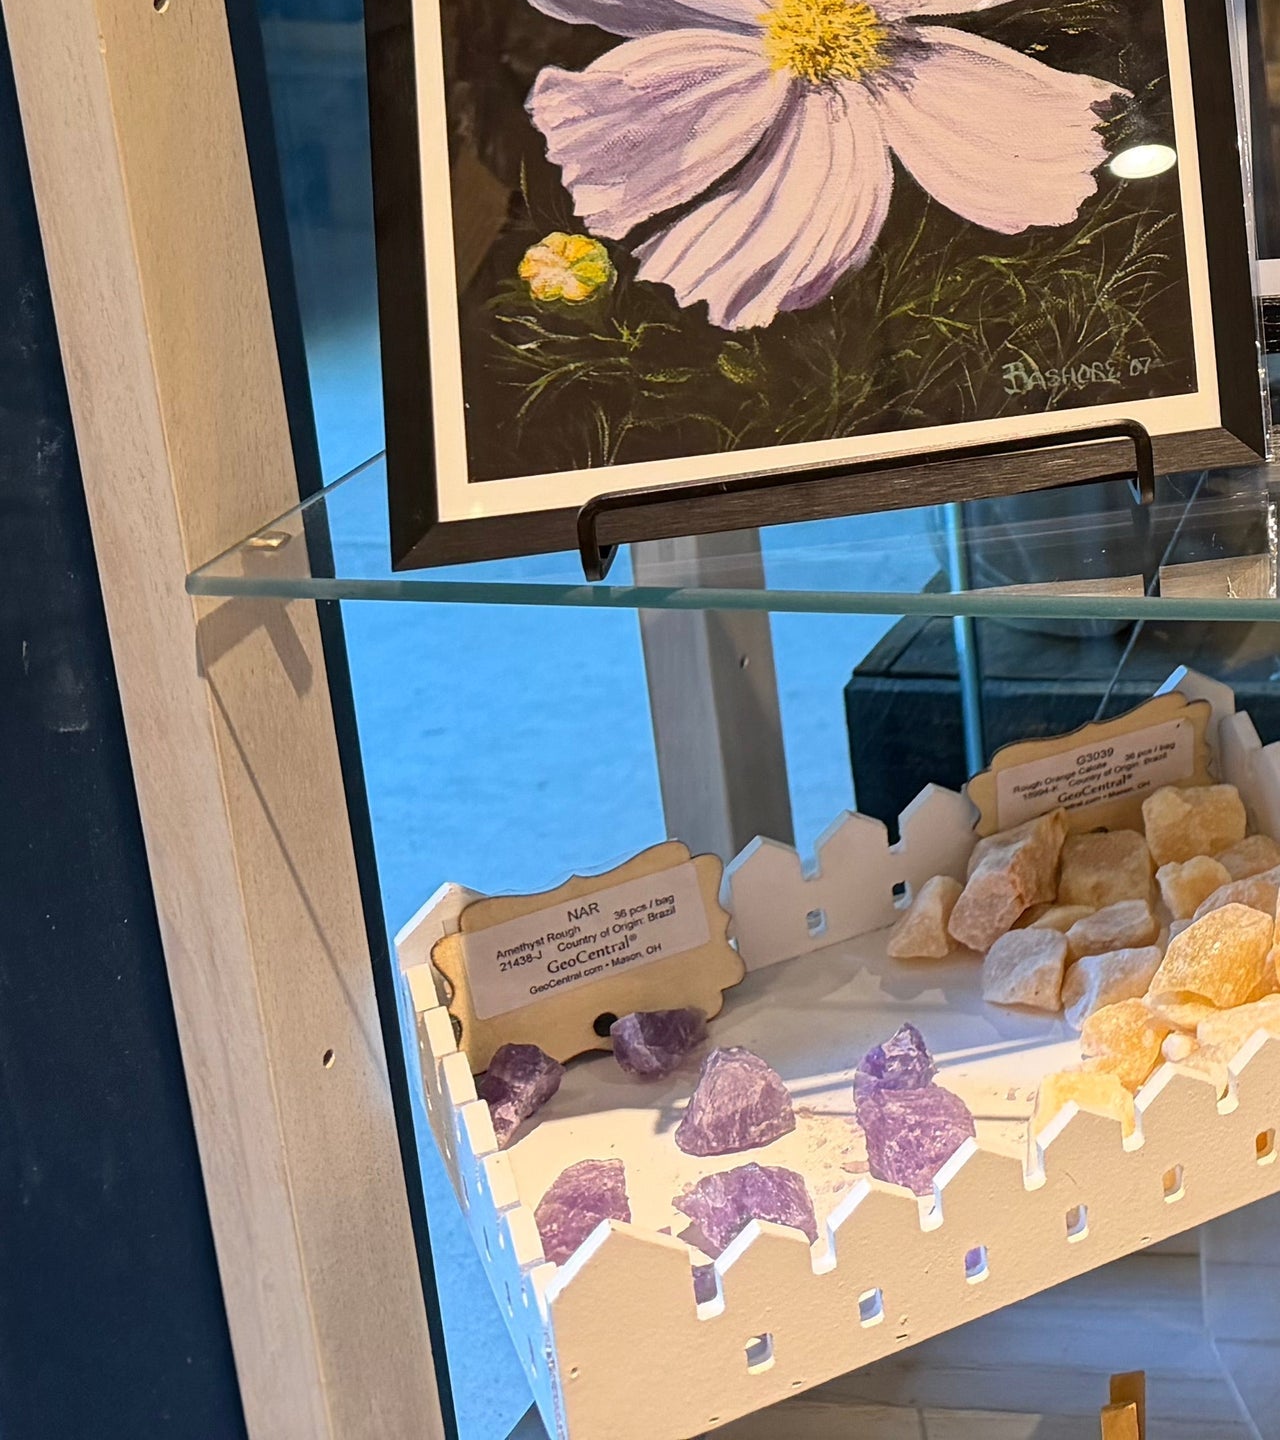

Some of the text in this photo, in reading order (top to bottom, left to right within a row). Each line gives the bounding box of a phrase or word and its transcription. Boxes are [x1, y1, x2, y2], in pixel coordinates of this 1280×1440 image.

[1076, 747, 1114, 766] G3039
[567, 902, 601, 923] NAR
[496, 936, 545, 960] Amethyst
[546, 925, 581, 943] Rough
[613, 909, 628, 921] 36
[629, 904, 648, 918] pcs
[655, 894, 675, 906] bag
[499, 950, 543, 972] 21438-J
[557, 933, 598, 952] Country
[600, 926, 610, 938] of
[647, 905, 676, 922] Brazil
[645, 943, 662, 955] OH
